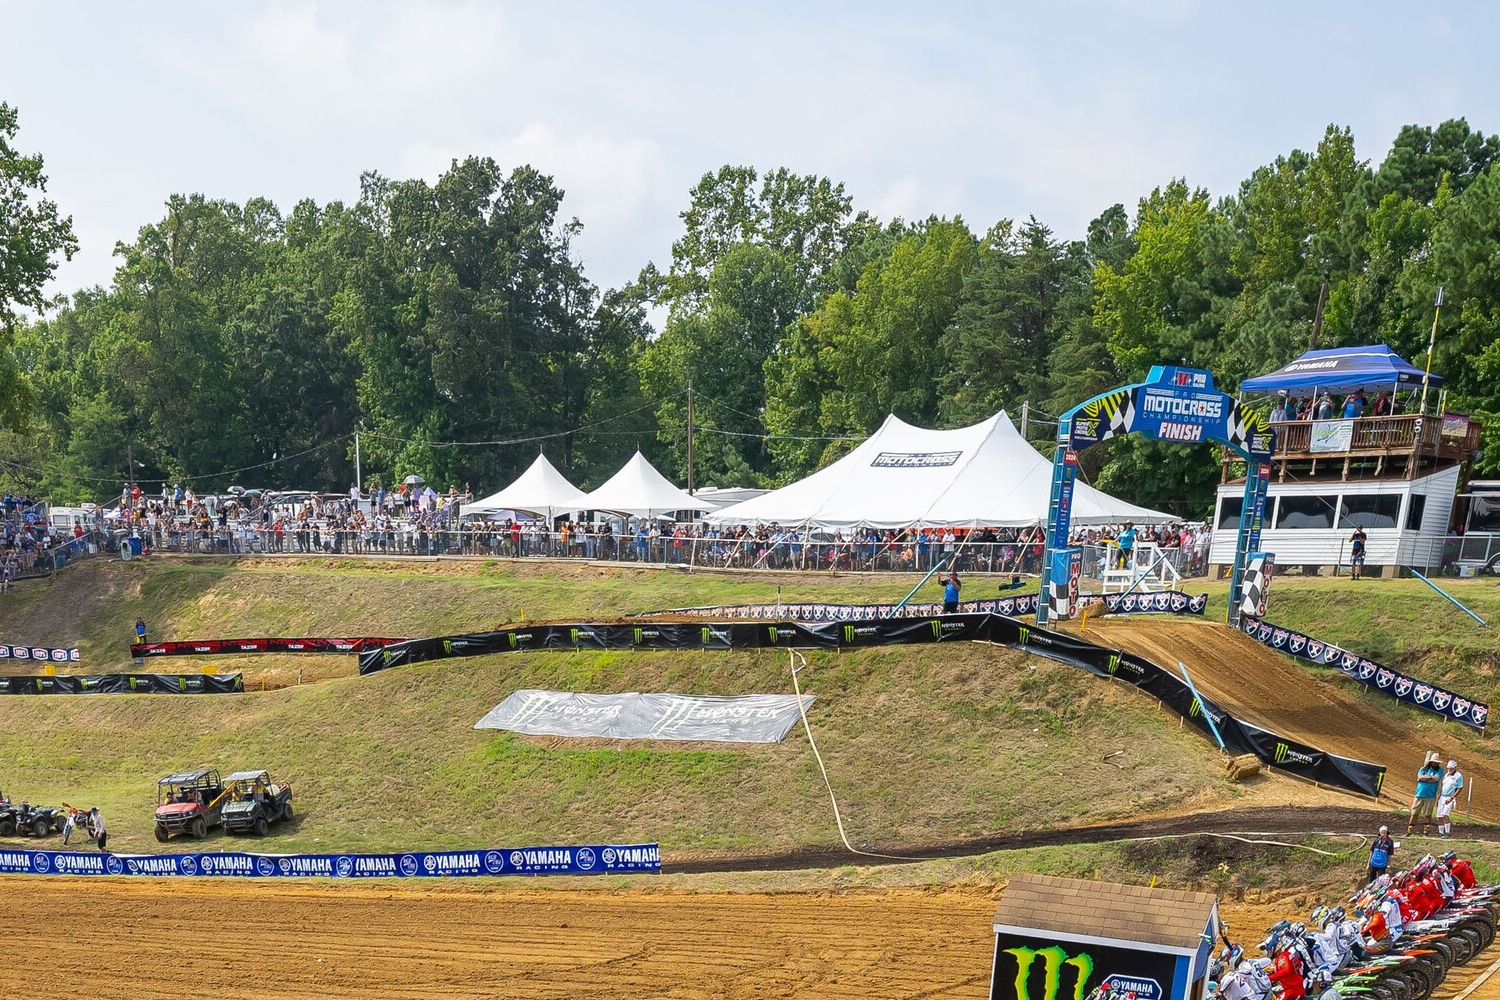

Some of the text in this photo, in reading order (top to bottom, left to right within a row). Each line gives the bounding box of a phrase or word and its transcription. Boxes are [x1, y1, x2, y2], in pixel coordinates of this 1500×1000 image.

[1296, 360, 1339, 371] YAMAHA
[1193, 374, 1206, 383] PRO
[1175, 391, 1195, 399] PRO
[1144, 395, 1222, 418] MOTOCROSS
[1143, 412, 1220, 424] CHAMPIONSHIP
[1158, 422, 1202, 440] FINISH
[874, 456, 957, 464] MOTOCROSS
[1068, 562, 1081, 618] MOTO
[1259, 564, 1273, 614] MOTO
[1121, 659, 1145, 674] MONSTER
[696, 707, 782, 719] MONSTER
[1287, 750, 1312, 763] MONSTER
[65, 855, 103, 869] YAMAHA
[212, 857, 253, 870] YAMAHA
[436, 854, 480, 869] YAMAHA
[522, 850, 571, 865] YAMAHA
[137, 859, 177, 871] YAMAHA
[290, 859, 332, 871] YAMAHA
[1121, 981, 1153, 995] YAMAHA
